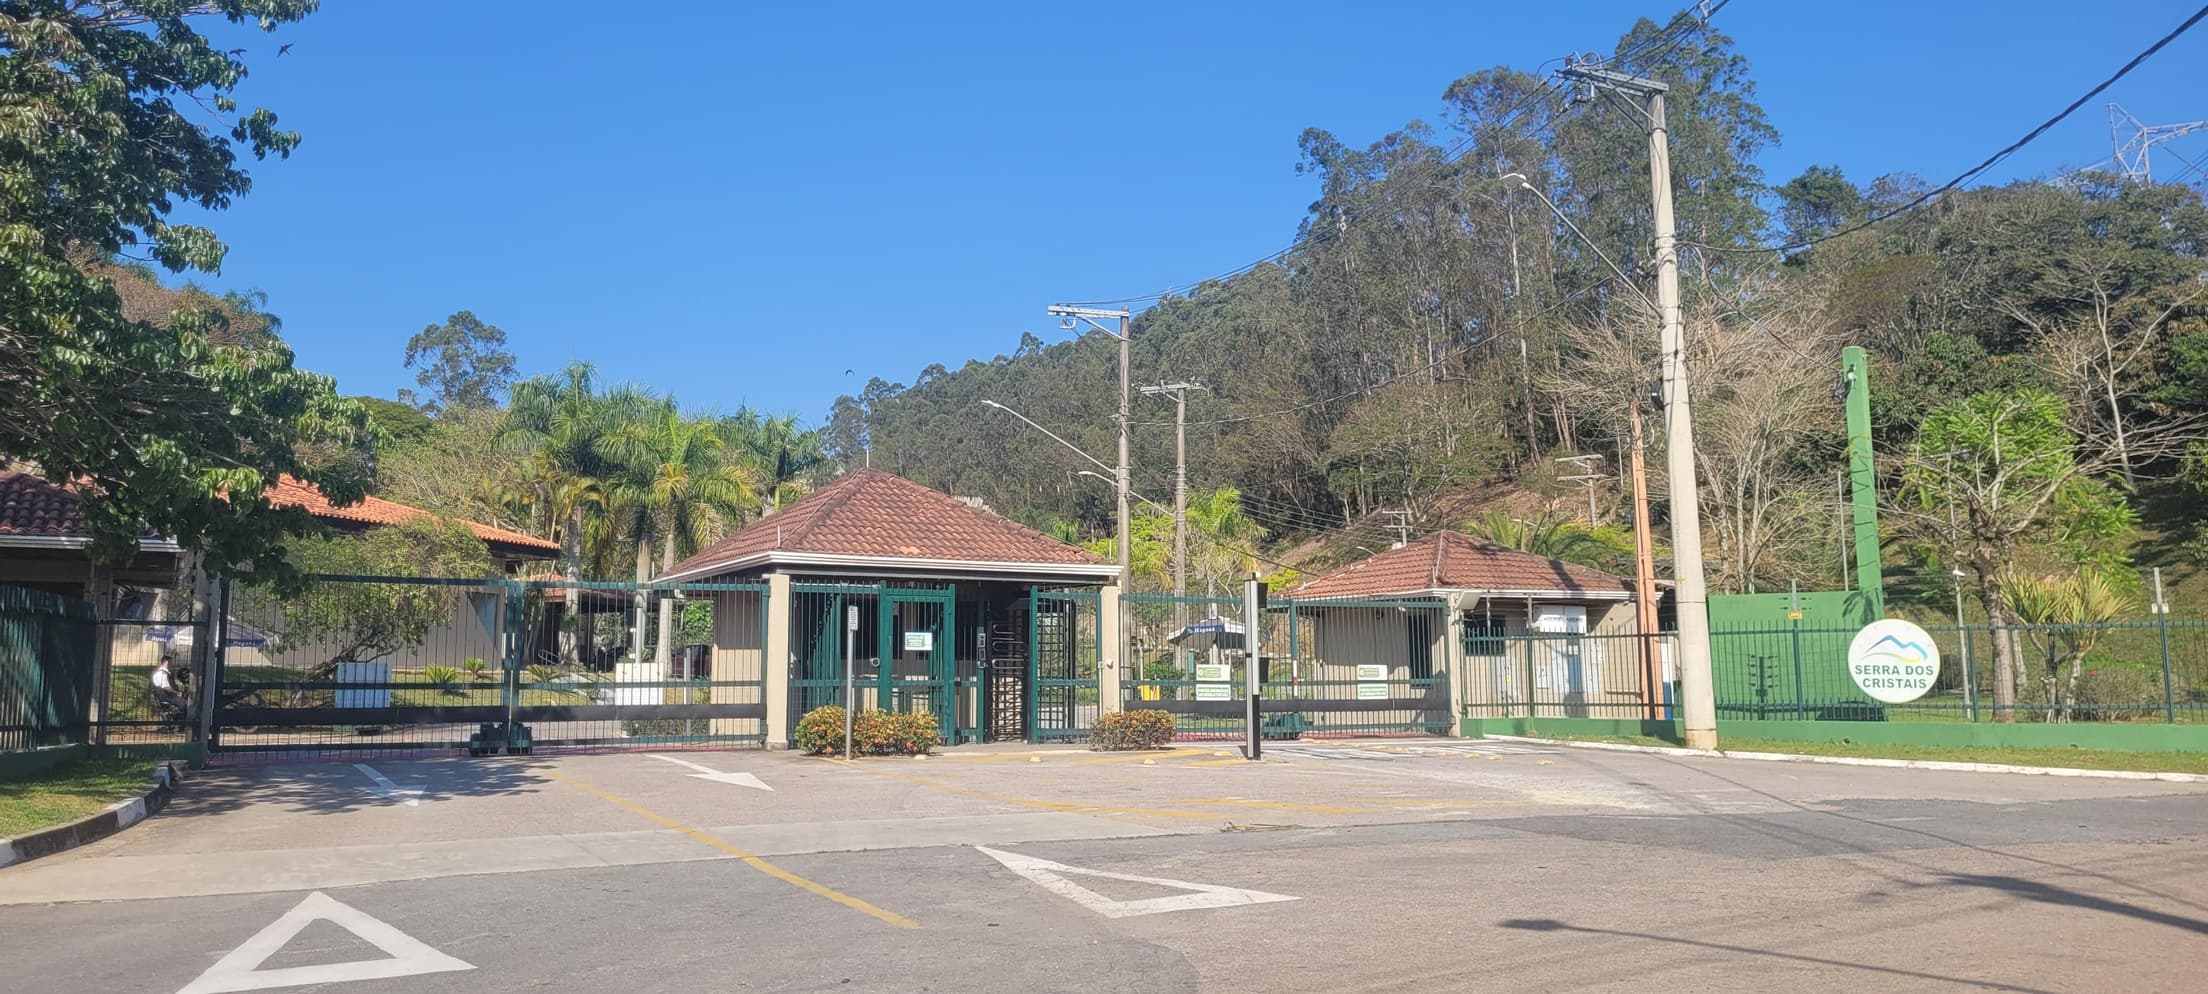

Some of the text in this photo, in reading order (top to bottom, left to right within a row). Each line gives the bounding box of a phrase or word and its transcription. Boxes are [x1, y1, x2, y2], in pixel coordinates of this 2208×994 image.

[1855, 664, 1934, 676] SERRA DOS
[1862, 678, 1927, 689] CRISTAIS
